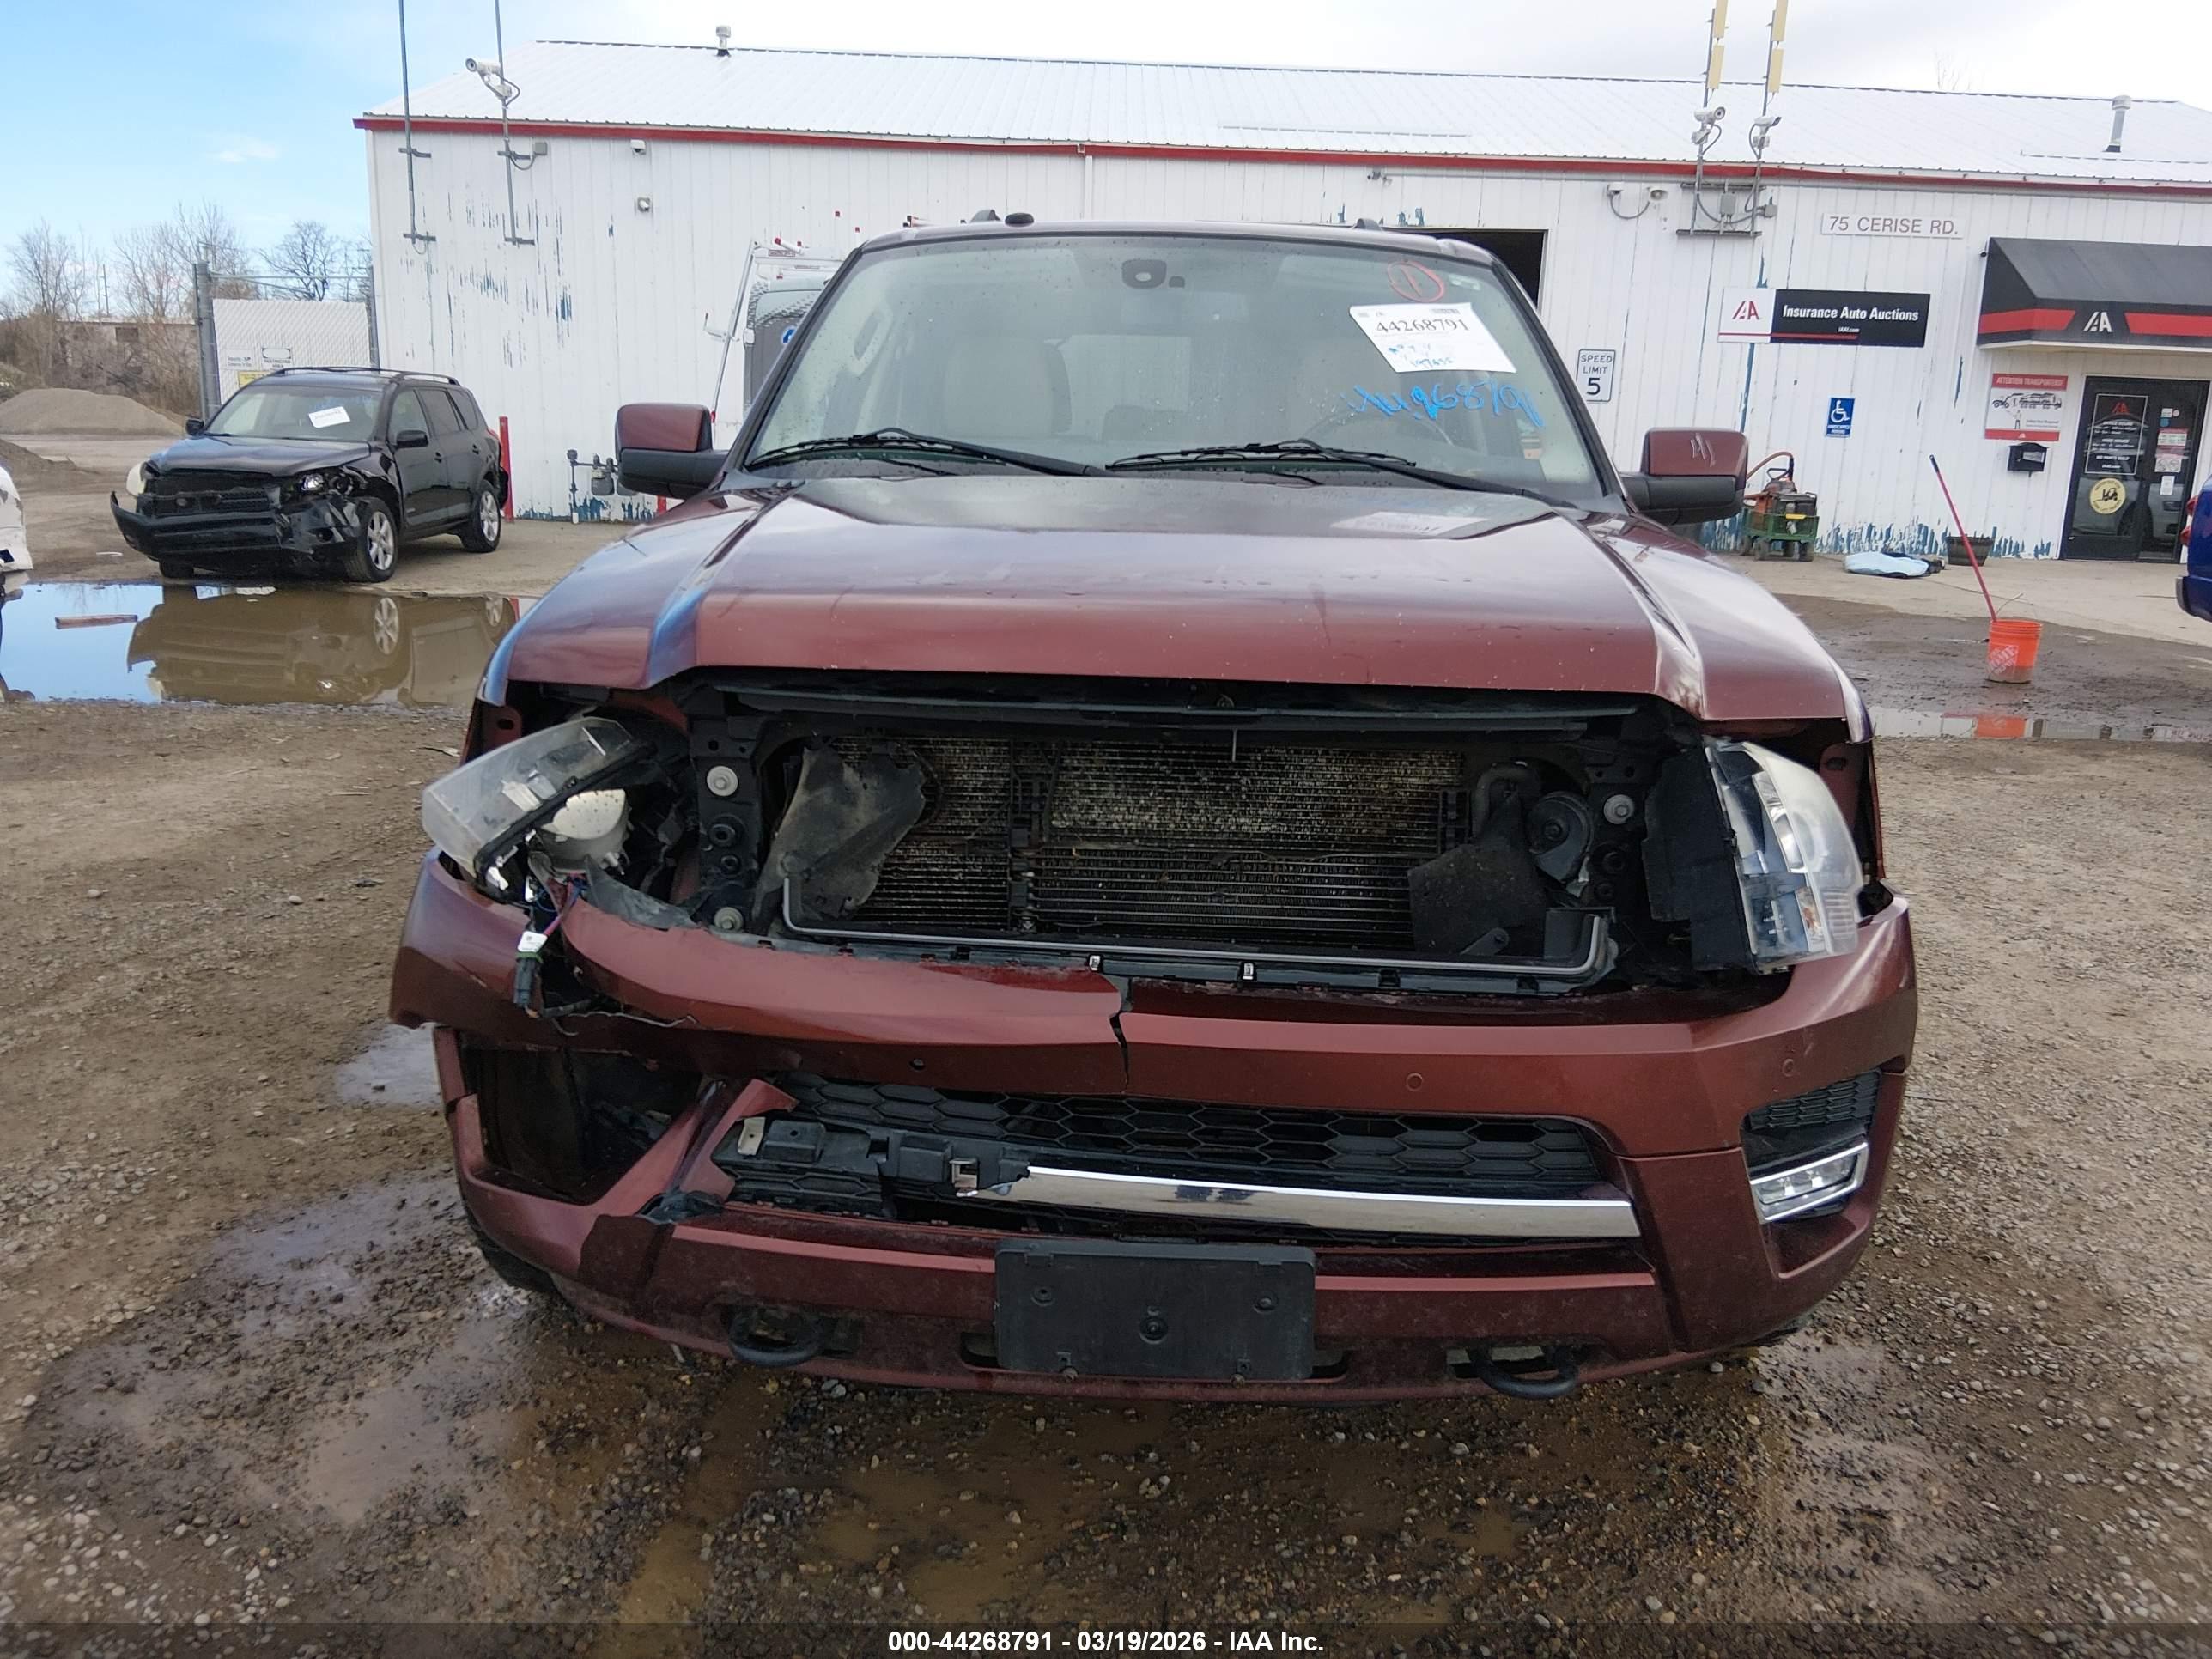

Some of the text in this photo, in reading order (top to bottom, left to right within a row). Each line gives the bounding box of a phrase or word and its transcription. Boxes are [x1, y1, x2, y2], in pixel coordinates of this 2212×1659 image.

[1829, 216, 1959, 234] 75 CERISE RD.
[1783, 304, 1920, 321] Insurance Auto Auctions
[1376, 318, 1470, 333] 44268791
[1580, 354, 1613, 363] SPEED
[1583, 365, 1608, 374] LIMIT
[1586, 377, 1601, 396] 5
